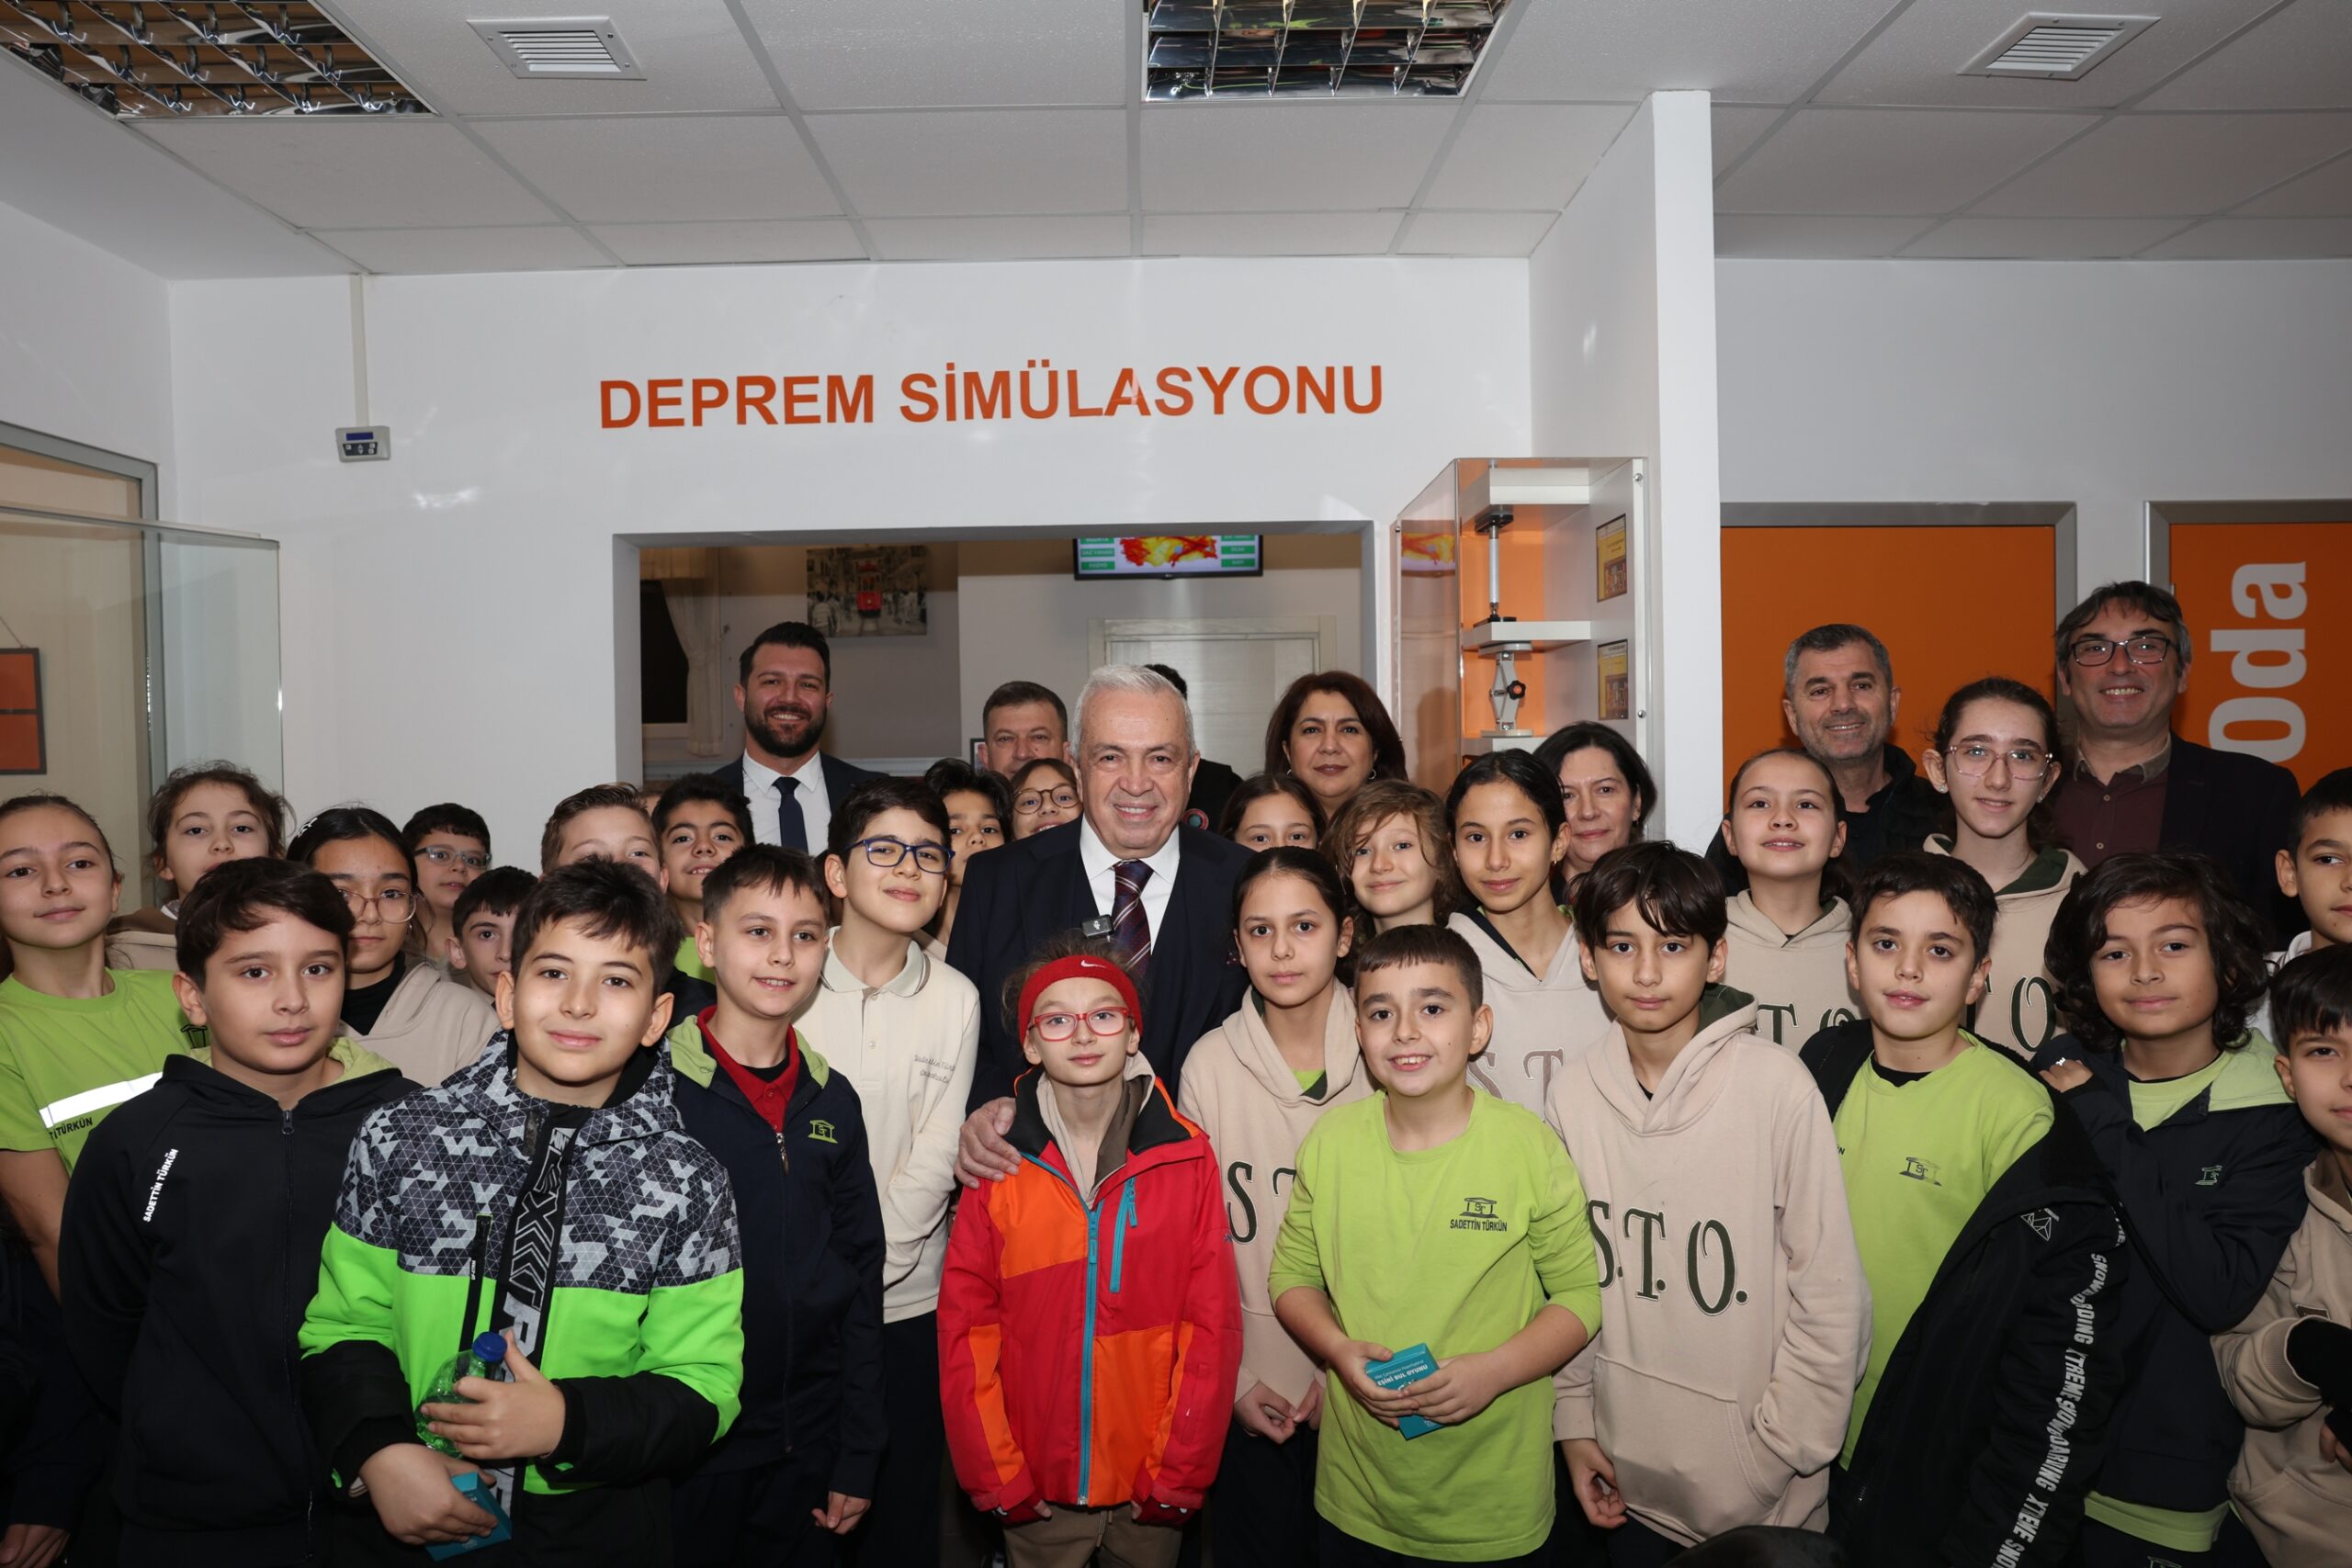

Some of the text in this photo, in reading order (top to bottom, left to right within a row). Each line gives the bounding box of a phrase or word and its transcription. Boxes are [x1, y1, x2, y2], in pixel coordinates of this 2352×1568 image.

[600, 359, 1384, 429] DEPREM SİMÜLASYONU
[2208, 560, 2308, 763] Oda
[143, 1148, 179, 1223] SADETTİN TÜRKÜN
[1450, 1219, 1508, 1232] SADETTİN TÜRKÜN
[1588, 1200, 1748, 1314] S.T.O.
[2013, 1493, 2049, 1543] XTEME
[1990, 1539, 2026, 1568] SNO
